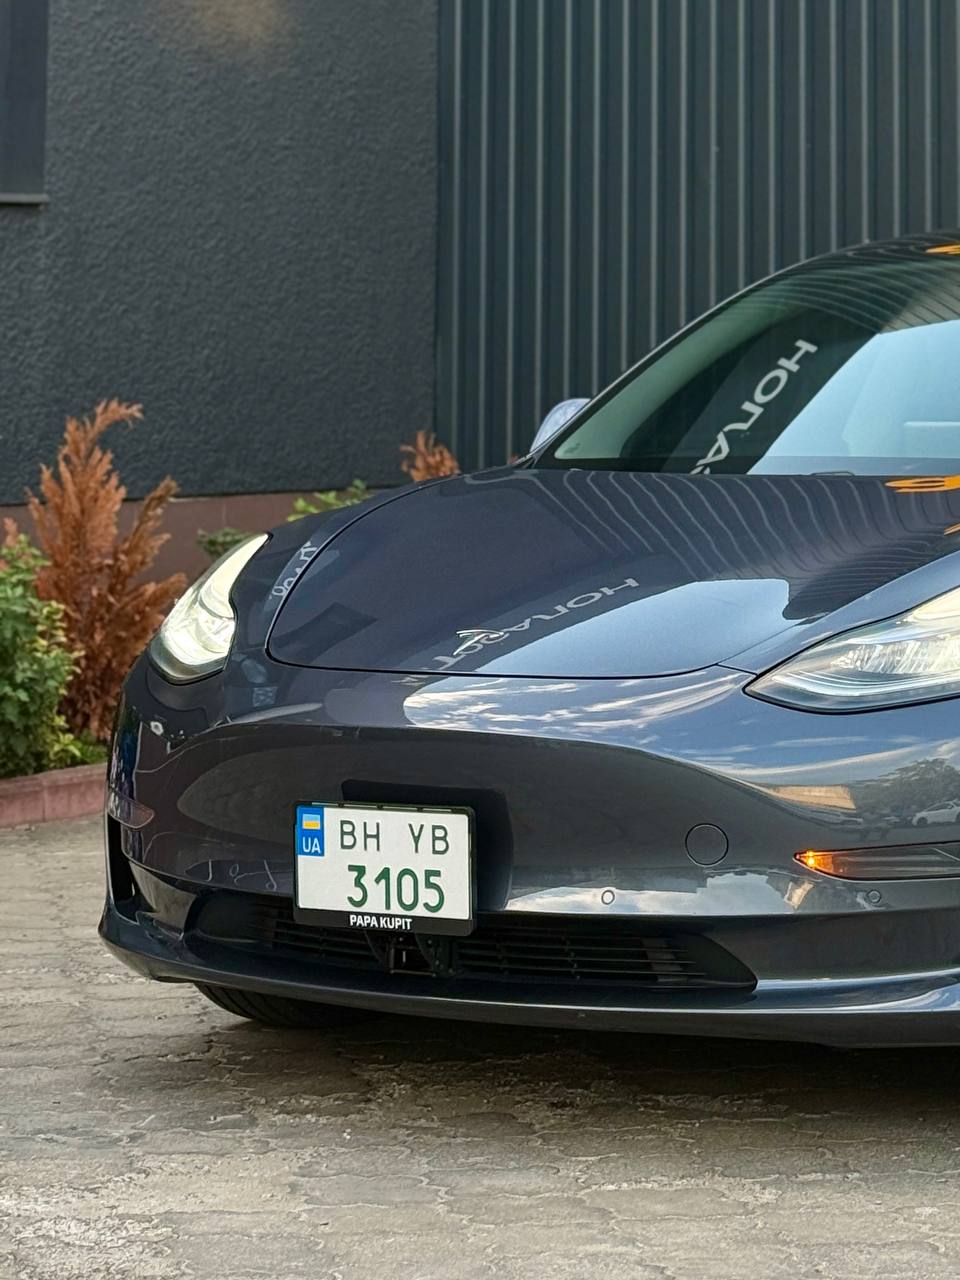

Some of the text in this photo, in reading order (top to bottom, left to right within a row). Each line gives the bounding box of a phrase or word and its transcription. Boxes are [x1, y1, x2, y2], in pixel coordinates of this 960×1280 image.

[302, 837, 321, 854] UA
[339, 820, 450, 855] BH YB
[347, 865, 445, 913] 3105
[349, 914, 412, 930] PAPA KUPIT
